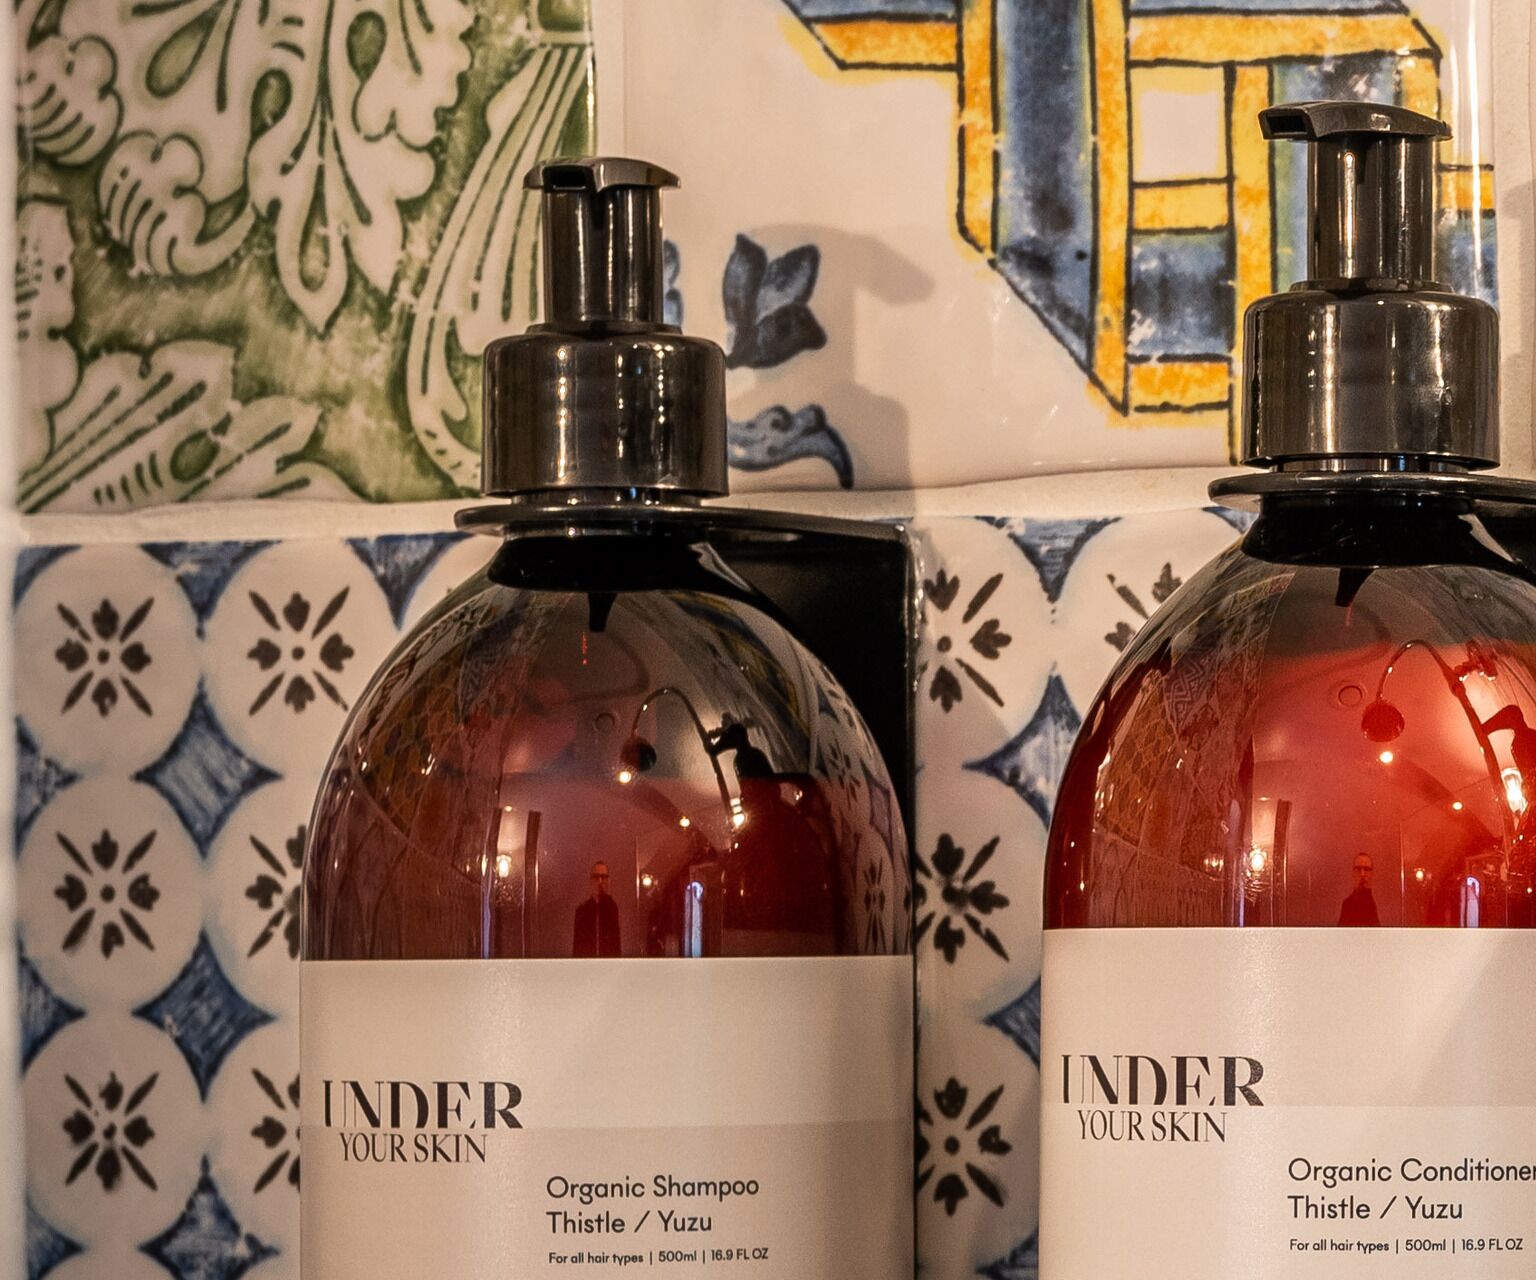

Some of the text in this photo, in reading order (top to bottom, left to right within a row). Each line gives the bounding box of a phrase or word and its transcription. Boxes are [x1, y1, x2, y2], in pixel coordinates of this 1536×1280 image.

[1061, 1054, 1264, 1107] UNDER
[322, 1080, 523, 1130] UNDER
[1077, 1109, 1228, 1143] YOUR SKIN
[339, 1132, 488, 1163] YOUR SKIN
[1288, 1157, 1392, 1189] Organic
[546, 1174, 759, 1206] Organic Shampoo
[545, 1209, 712, 1234] Thistle / Yuzu
[1287, 1194, 1463, 1220] Thistle / Yuzu
[548, 1247, 769, 1267] For all hair types 500ml 16.9 FL OZ
[1290, 1238, 1524, 1255] For all hair types 500ml 16.9 FL OZ
